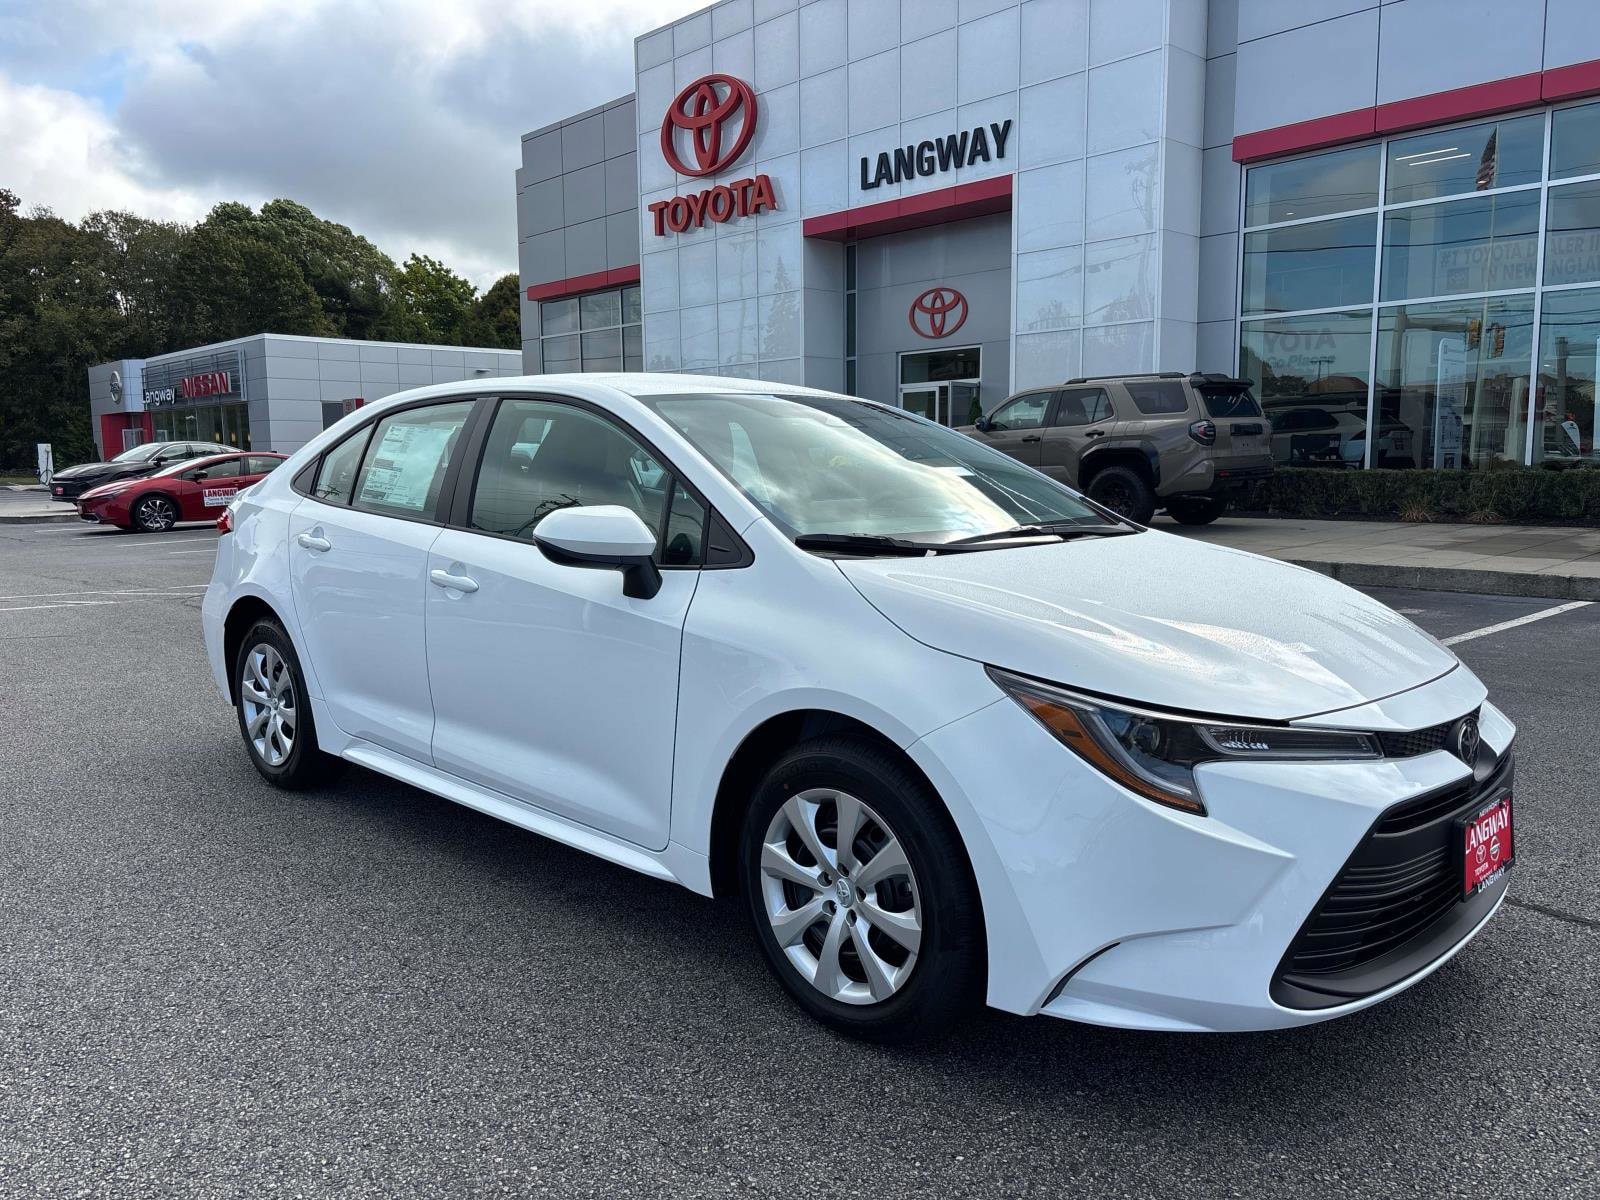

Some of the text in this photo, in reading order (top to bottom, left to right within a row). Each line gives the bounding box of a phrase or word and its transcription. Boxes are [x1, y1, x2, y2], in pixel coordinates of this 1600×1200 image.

[860, 119, 1013, 190] LANGWAY
[648, 174, 779, 237] TOYOTA
[1465, 240, 1522, 265] TOYOTA
[142, 387, 175, 406] Langway
[182, 372, 232, 398] NISSAN
[203, 487, 238, 498] LANGWAY
[1465, 805, 1510, 855] LANGWAY
[1477, 865, 1506, 893] LANGWAY
